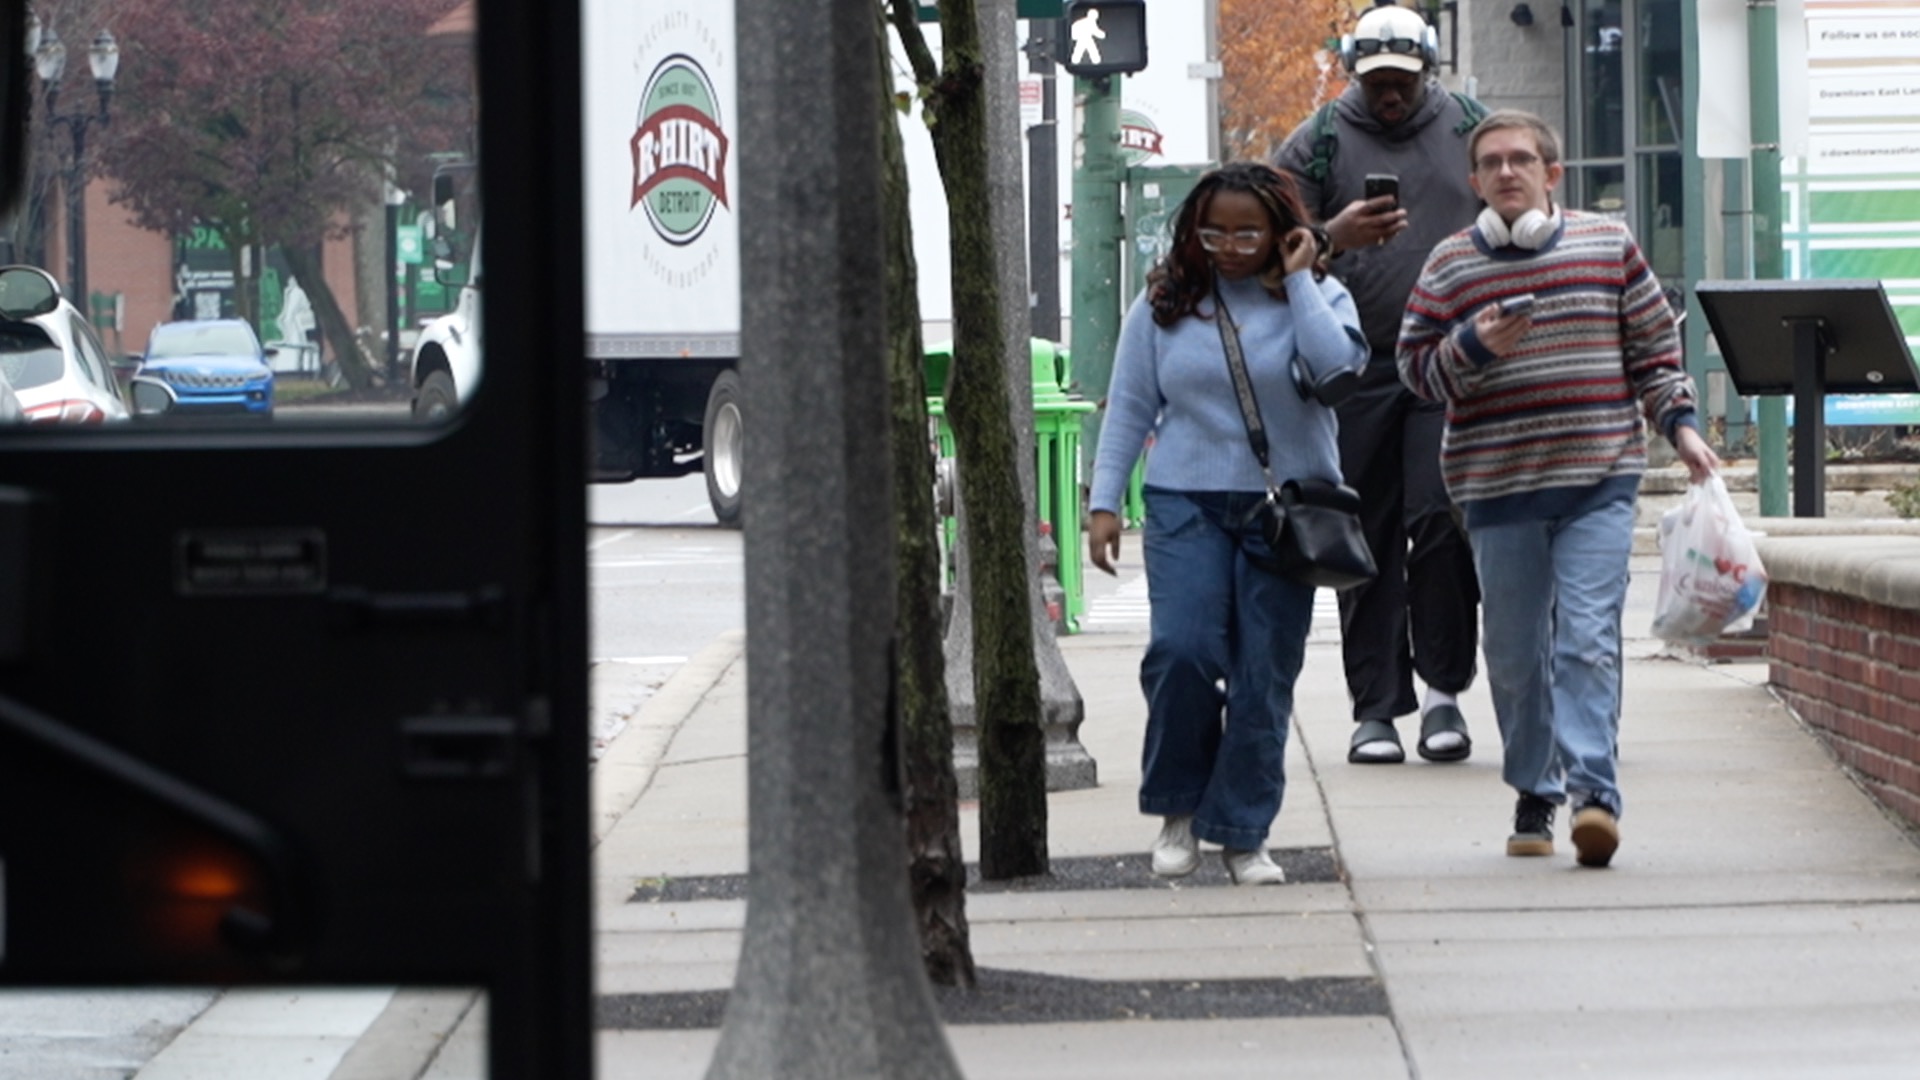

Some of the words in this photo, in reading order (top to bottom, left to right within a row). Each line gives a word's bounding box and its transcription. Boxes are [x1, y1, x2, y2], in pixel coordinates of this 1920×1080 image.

[1821, 30, 1861, 40] Follow
[1865, 31, 1878, 40] us
[1882, 31, 1898, 39] on
[1820, 89, 1875, 99] Downtown
[1878, 88, 1901, 97] East
[659, 190, 701, 213] DETROIT
